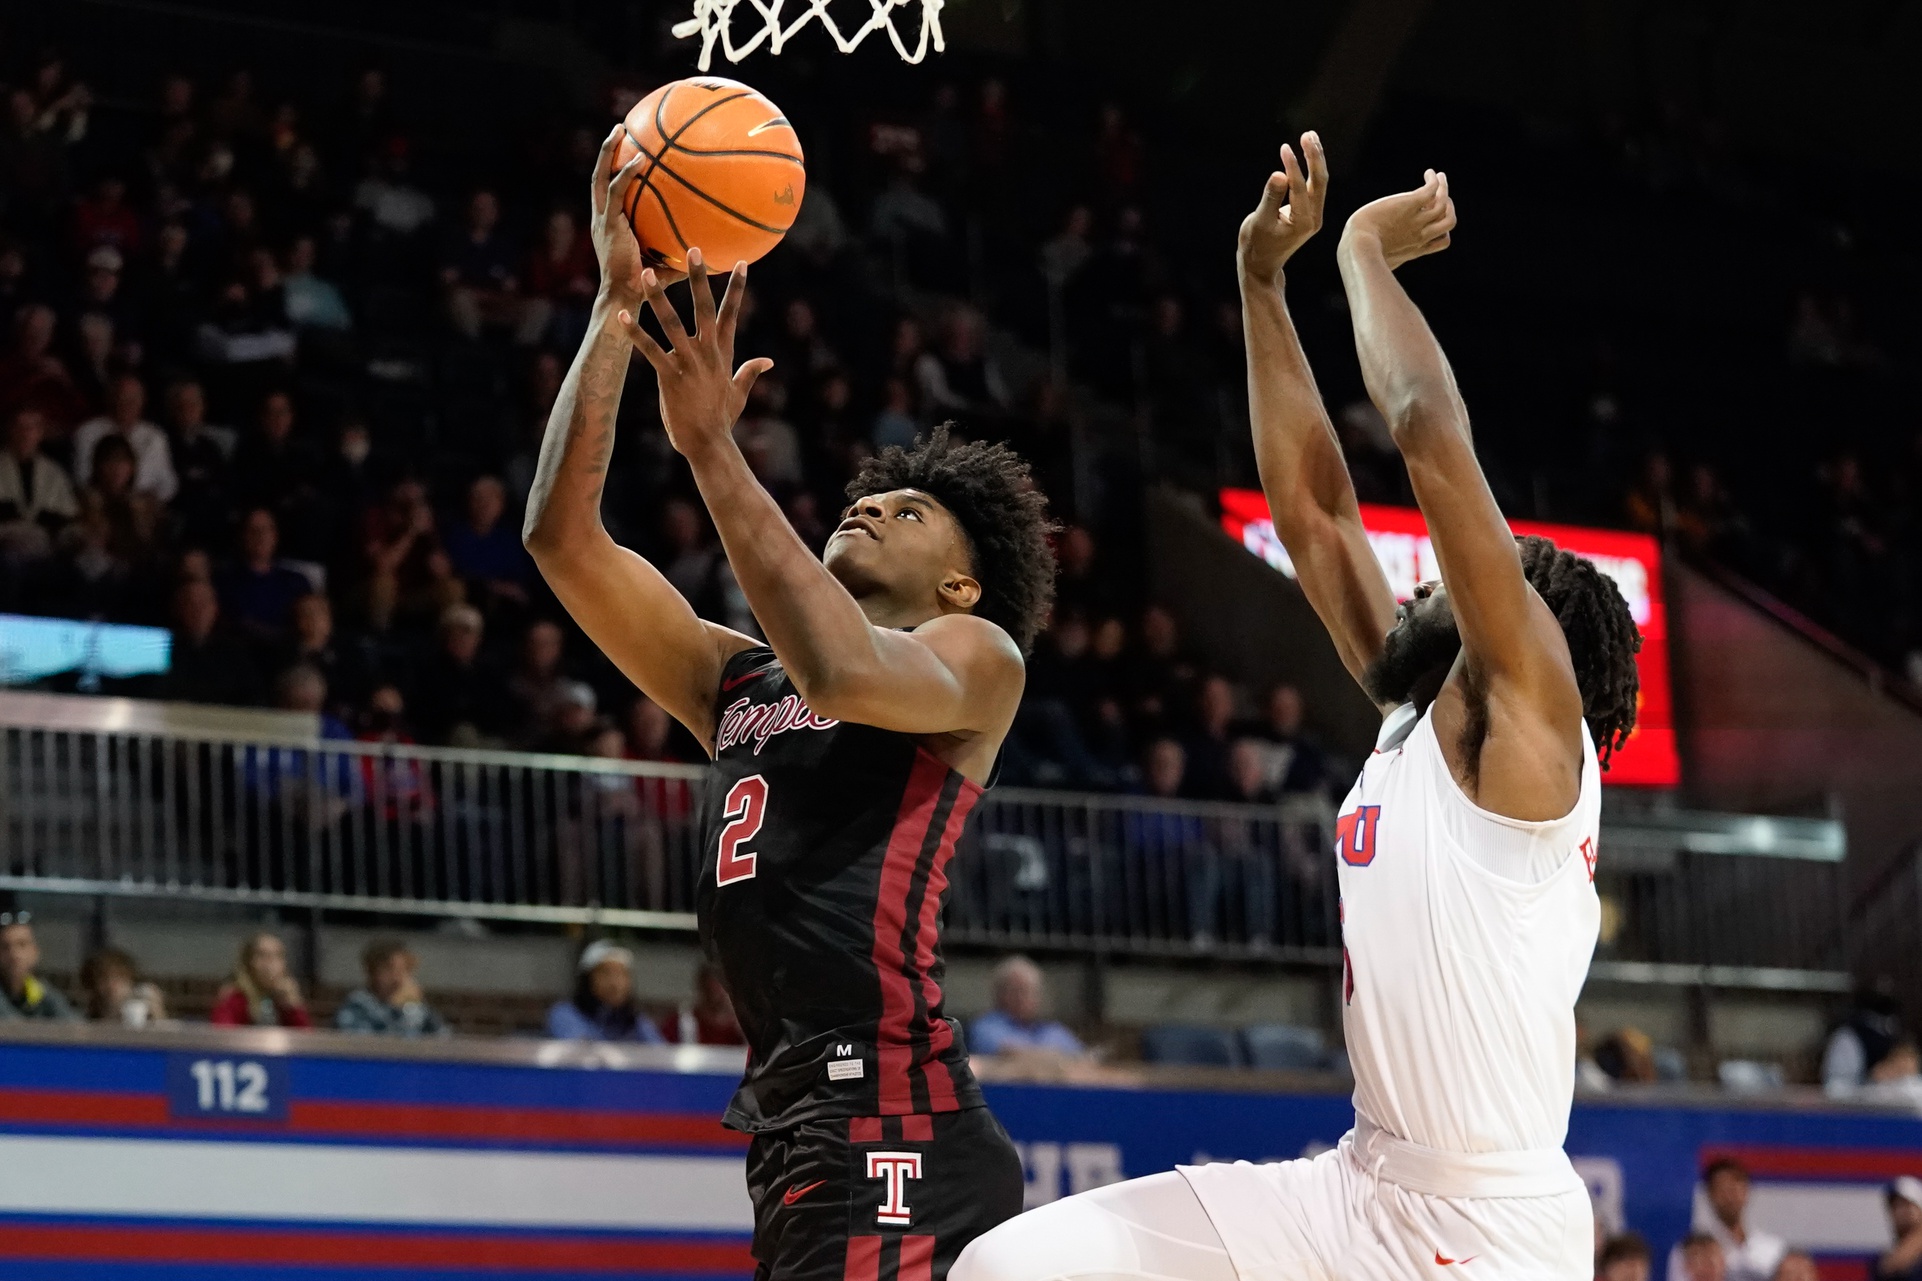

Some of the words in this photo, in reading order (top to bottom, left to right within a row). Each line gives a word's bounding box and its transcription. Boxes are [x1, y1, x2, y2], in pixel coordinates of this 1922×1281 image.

[716, 773, 769, 888] 2
[1335, 804, 1381, 867] U
[836, 1044, 852, 1057] M
[190, 1060, 269, 1112] 112
[866, 1151, 922, 1225] T
